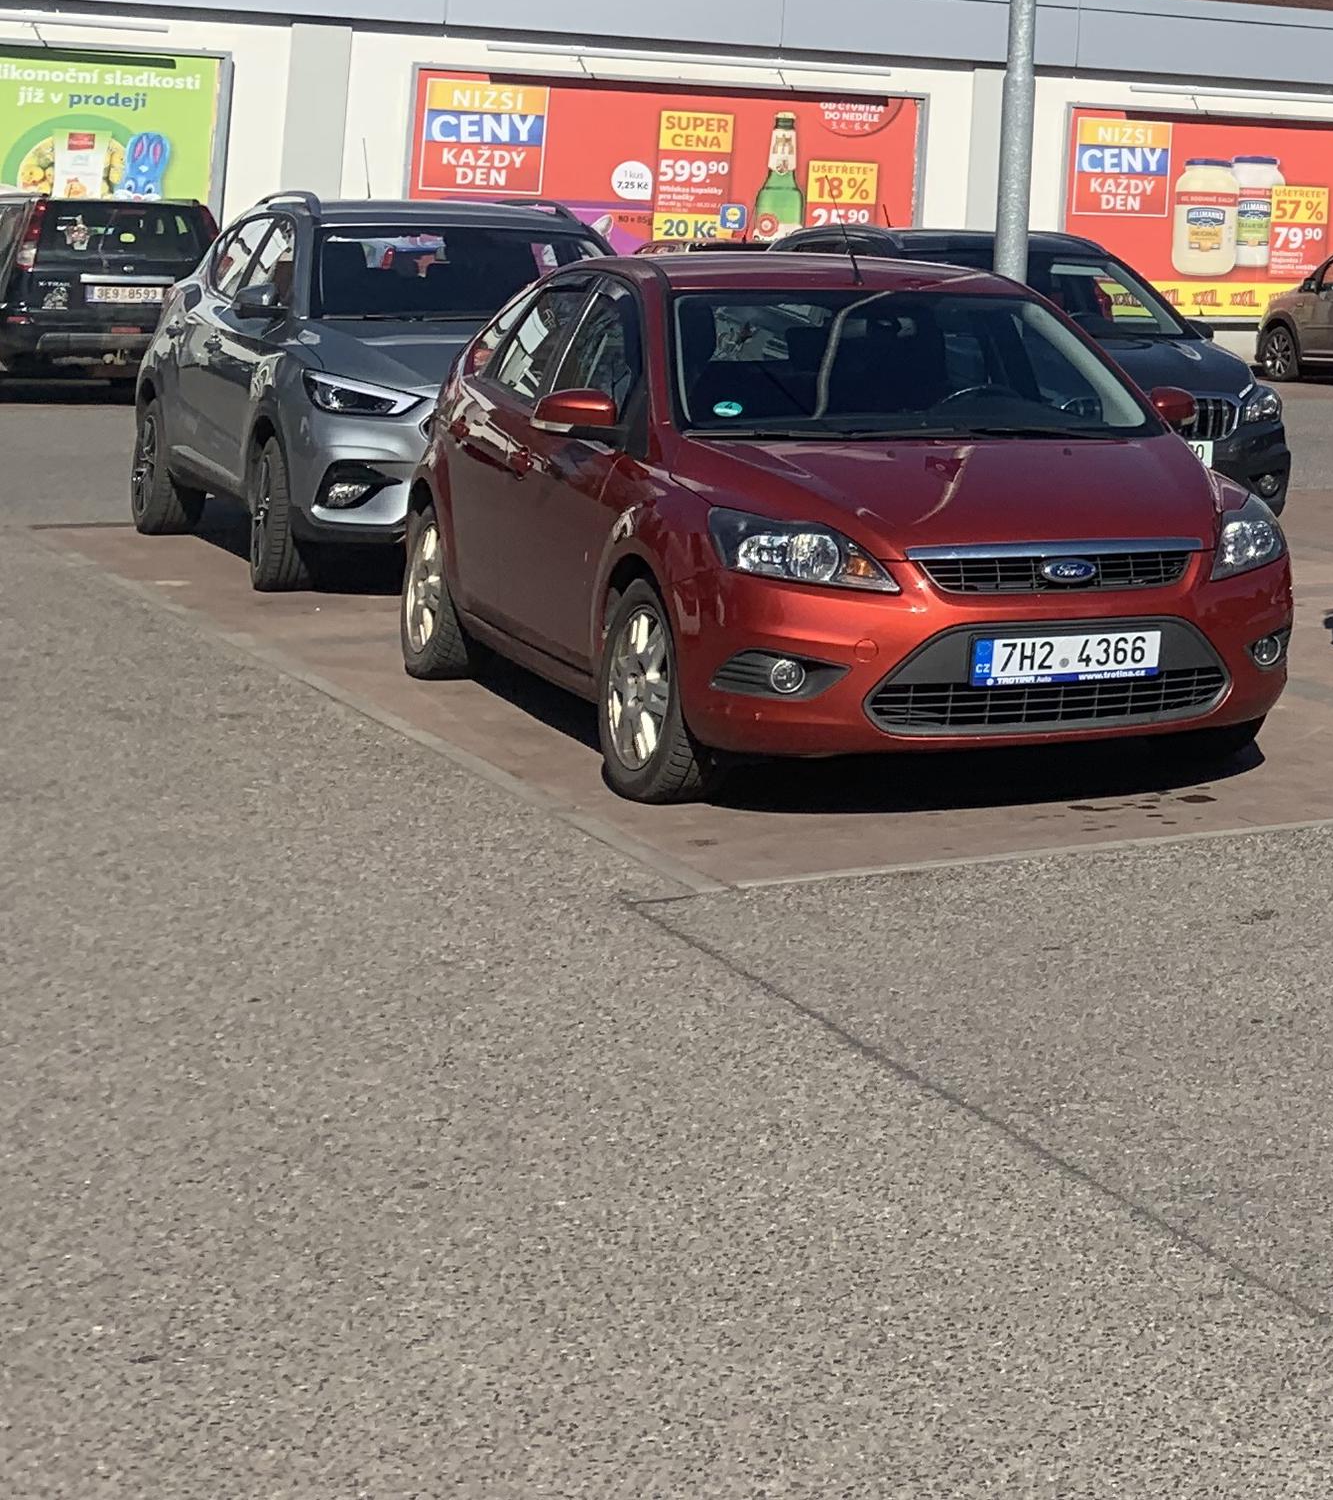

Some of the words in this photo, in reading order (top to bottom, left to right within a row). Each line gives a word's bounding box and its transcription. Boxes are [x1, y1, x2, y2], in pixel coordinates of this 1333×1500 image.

[104, 71, 200, 89] sladkosti
[17, 87, 45, 106] již
[50, 92, 63, 103] v
[69, 92, 147, 111] prodeji
[665, 116, 729, 133] SUPER
[824, 112, 840, 120] DO
[842, 111, 879, 122] NEDĚLE
[432, 113, 536, 142] CENY
[671, 134, 722, 148] CENA
[442, 146, 526, 168] KAŽDÝ
[1081, 147, 1162, 173] CENY
[456, 167, 507, 185] DEN
[617, 181, 635, 190] 7,25
[637, 181, 648, 190] Kč
[815, 177, 844, 199] 18
[848, 178, 869, 200] %
[1090, 176, 1155, 195] KAŽDÝ
[1100, 194, 1140, 210] DEN
[1275, 200, 1301, 220] 57
[1305, 201, 1324, 220] %
[655, 219, 688, 237] -20
[693, 220, 718, 238] Kč
[97, 288, 120, 299] 3E9
[128, 288, 157, 299] 8593
[1057, 564, 1085, 576] Ford
[1000, 641, 1055, 672] 7H2
[1077, 636, 1147, 667] 4366
[975, 664, 990, 674] CZ
[1078, 669, 1146, 681] www.trotina.cz
[1037, 675, 1052, 683] Auto
